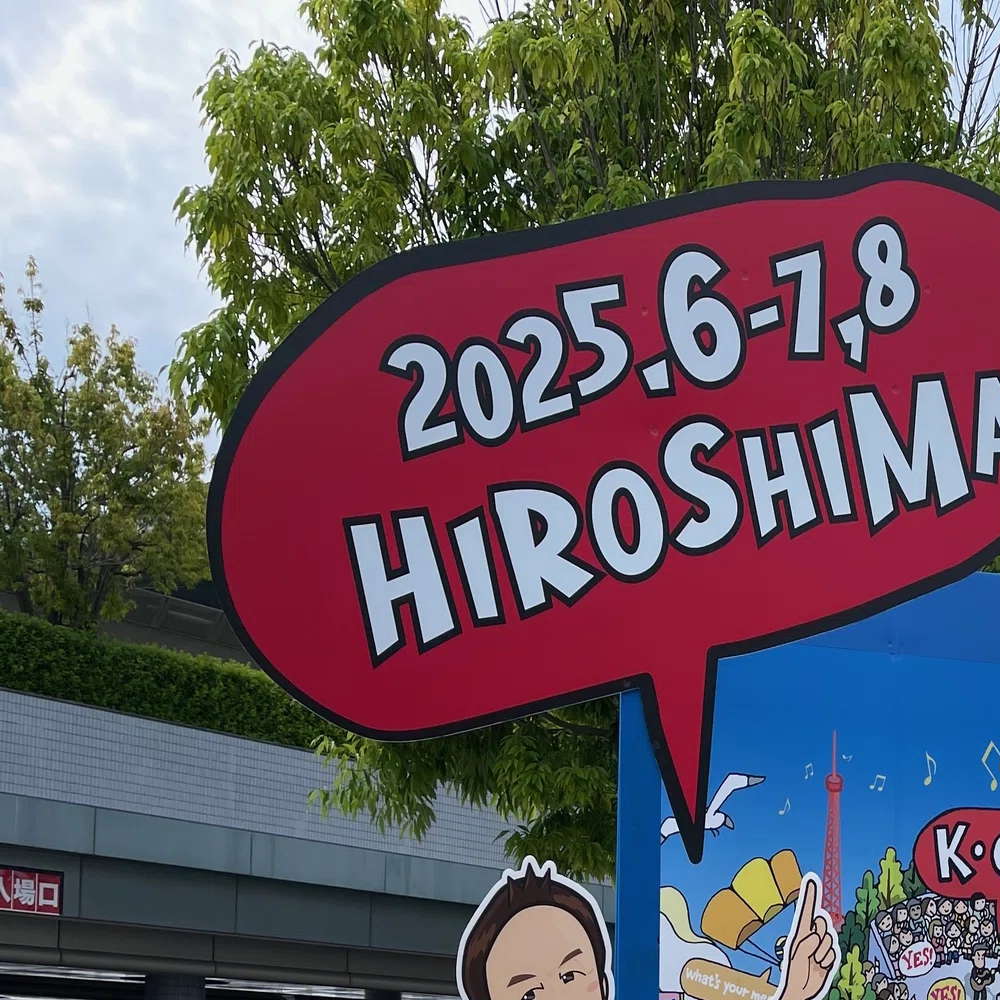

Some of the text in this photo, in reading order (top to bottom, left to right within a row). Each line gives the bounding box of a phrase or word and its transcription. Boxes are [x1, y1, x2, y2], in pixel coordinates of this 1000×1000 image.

[902, 948, 933, 970] YES!
[686, 968, 721, 990] what's
[723, 981, 750, 996] your
